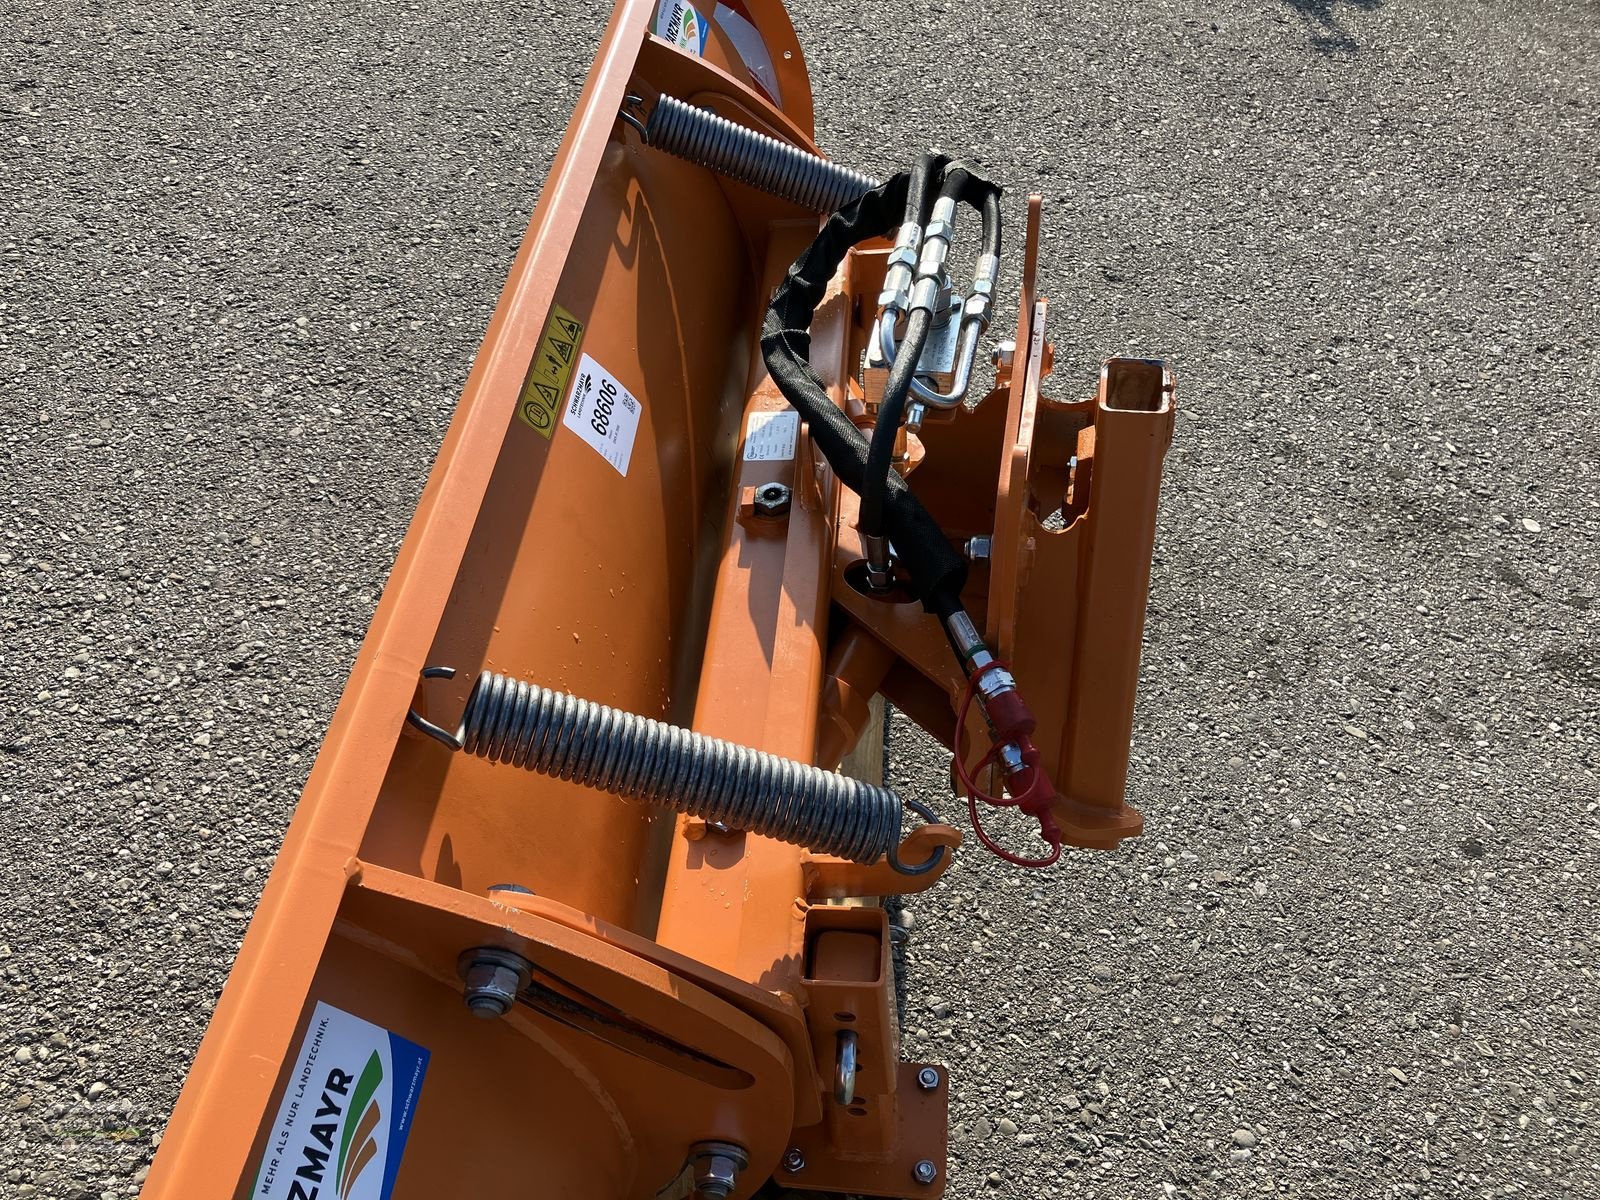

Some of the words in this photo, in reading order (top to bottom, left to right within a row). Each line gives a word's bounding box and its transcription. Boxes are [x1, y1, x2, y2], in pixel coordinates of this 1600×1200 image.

[571, 373, 586, 416] SCHWARZMAYR
[591, 378, 617, 436] 68606
[261, 1158, 280, 1195] MEHR
[276, 1130, 290, 1156] ALS
[285, 1101, 300, 1127] NUR
[296, 1017, 330, 1099] LANDTECHNIK.
[398, 1056, 423, 1132] www.schwarzmayr.at
[286, 1067, 354, 1200] ZMAYR
